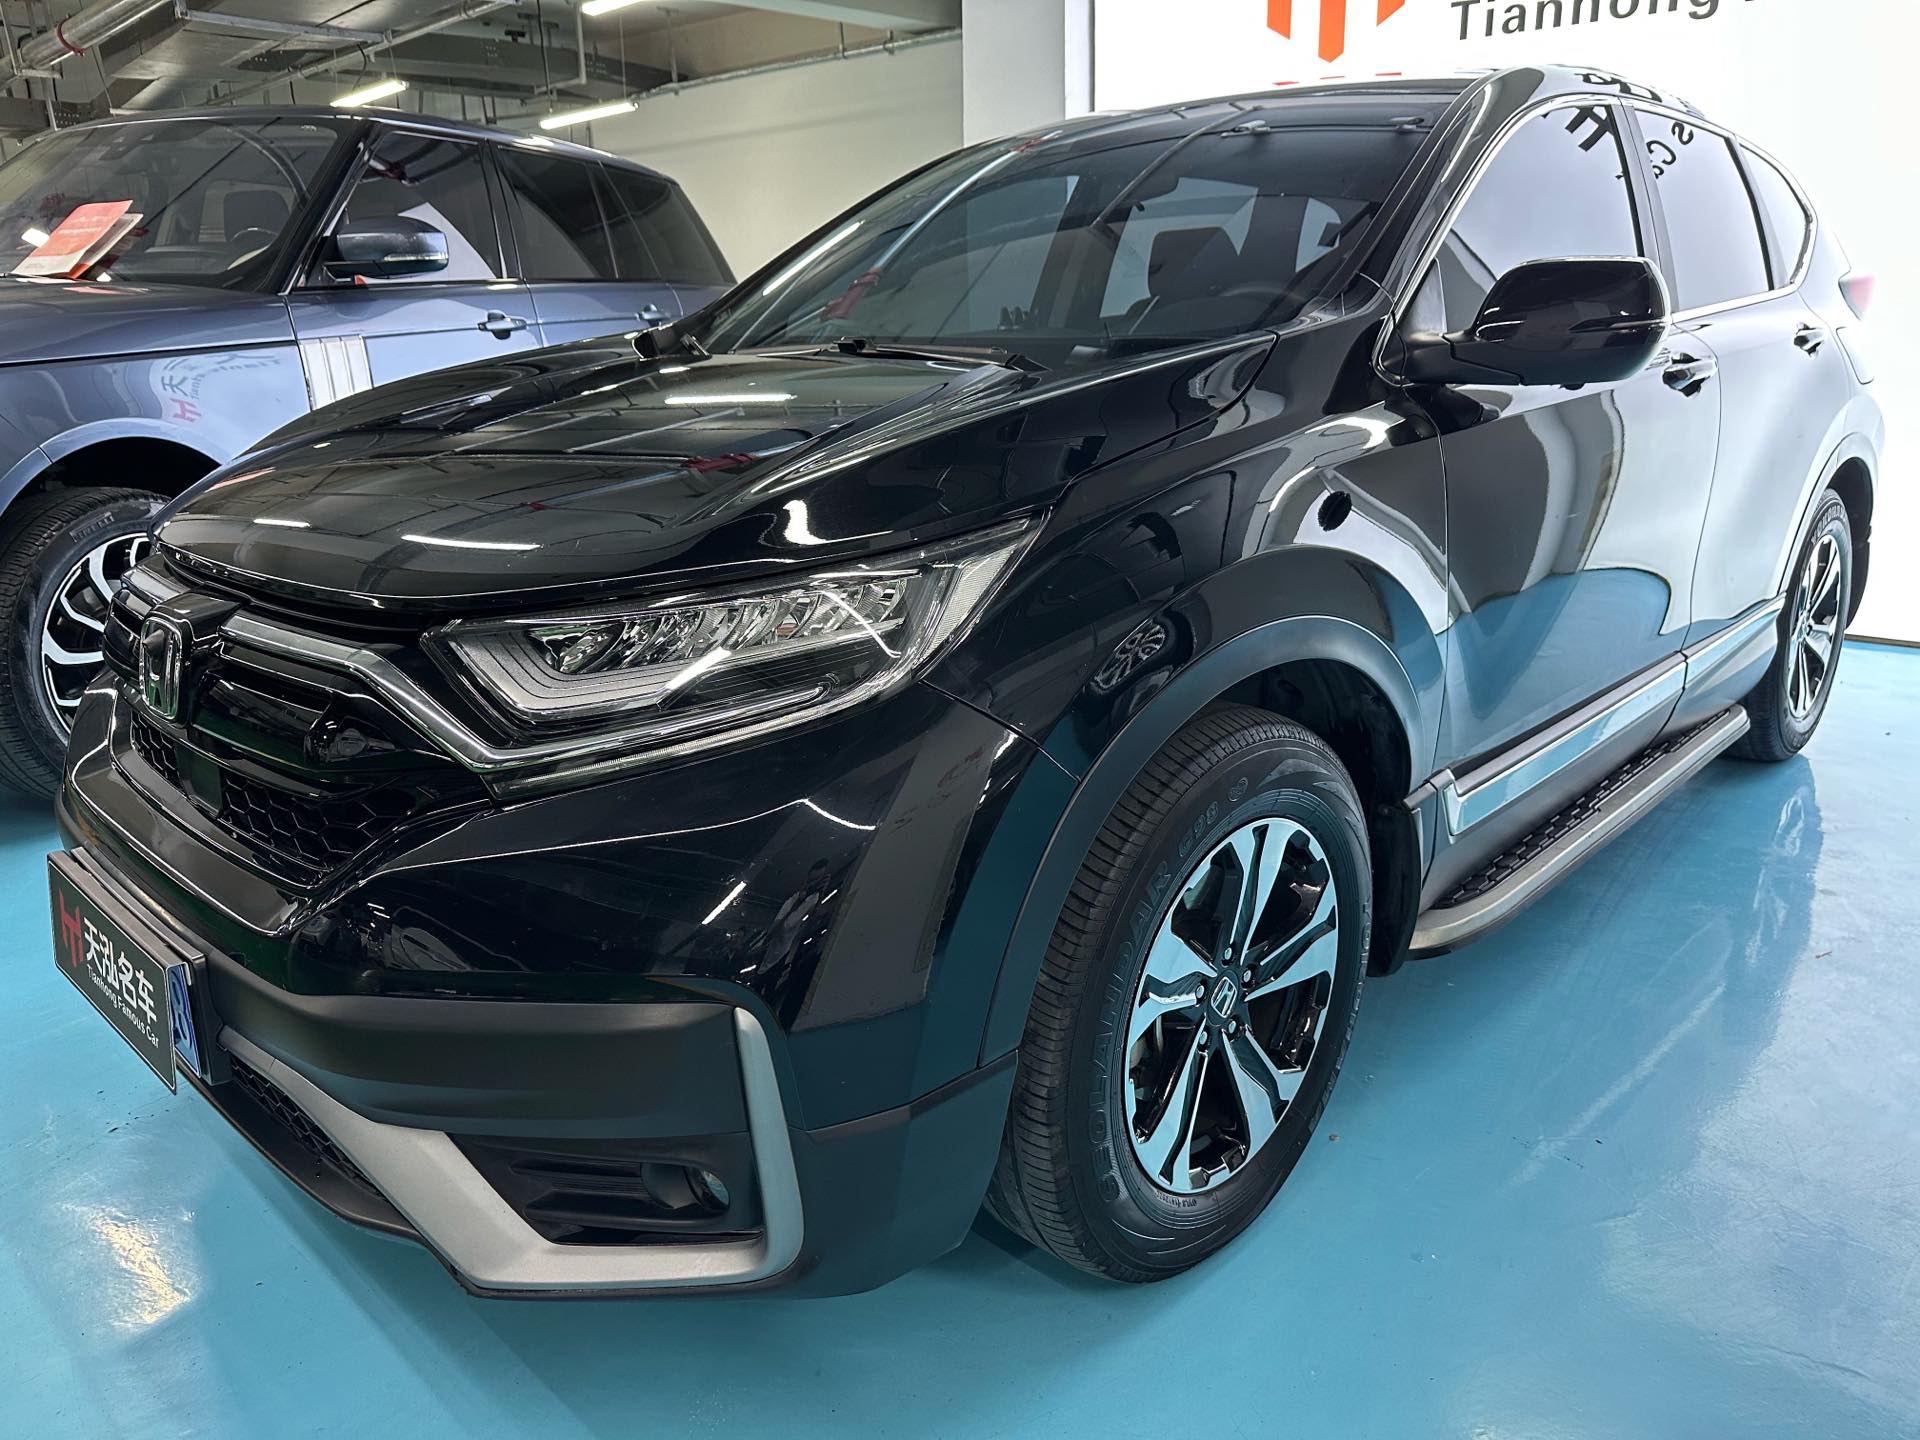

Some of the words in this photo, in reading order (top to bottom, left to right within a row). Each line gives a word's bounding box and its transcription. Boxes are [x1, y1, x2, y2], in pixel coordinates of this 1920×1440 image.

[84, 917, 158, 1024] 天泓名车
[87, 964, 118, 1009] Tianhong
[117, 994, 146, 1034] Famous
[146, 1025, 159, 1049] Car
[1089, 867, 1172, 1200] GEOLANDAR
